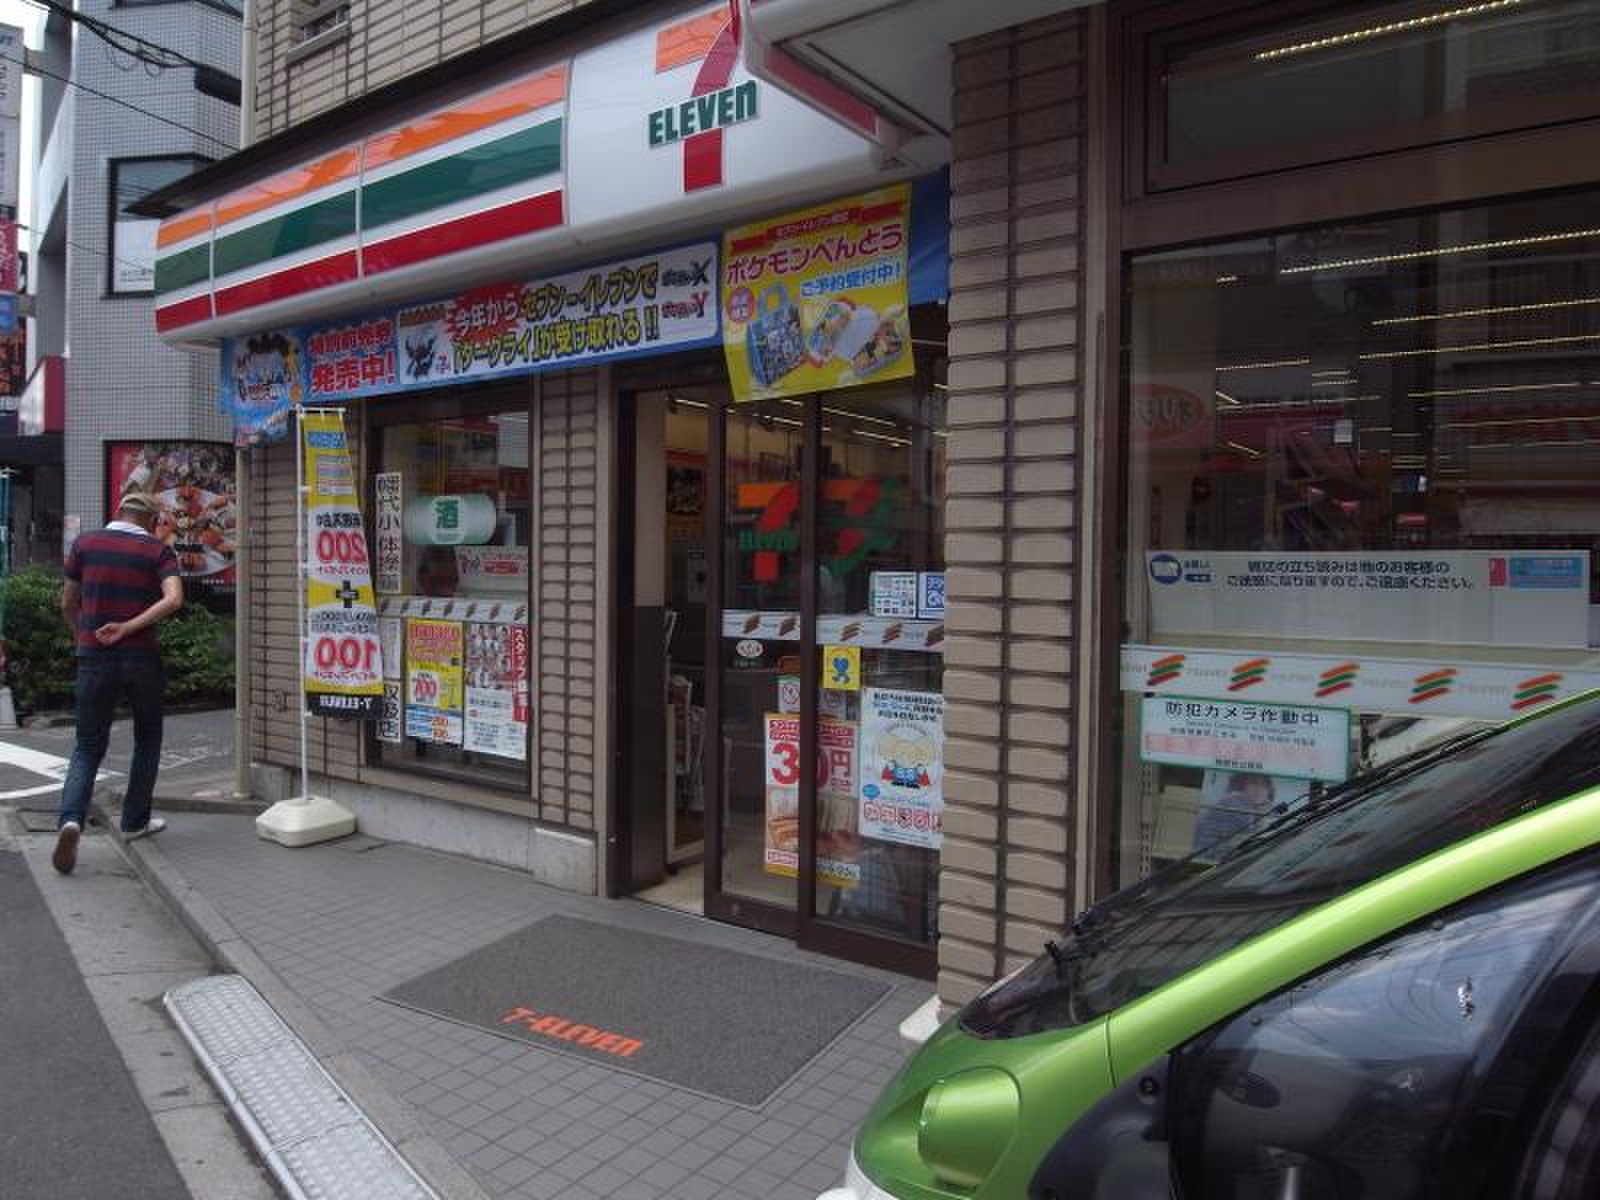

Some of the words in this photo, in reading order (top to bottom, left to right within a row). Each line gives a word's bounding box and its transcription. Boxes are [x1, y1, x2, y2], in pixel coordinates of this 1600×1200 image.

[656, 6, 739, 192] 7
[727, 224, 903, 285] ポケモンべんとう
[1165, 702, 1320, 727] 防犯カメラ作動中
[496, 1006, 643, 1057] 7-ELEVEN
